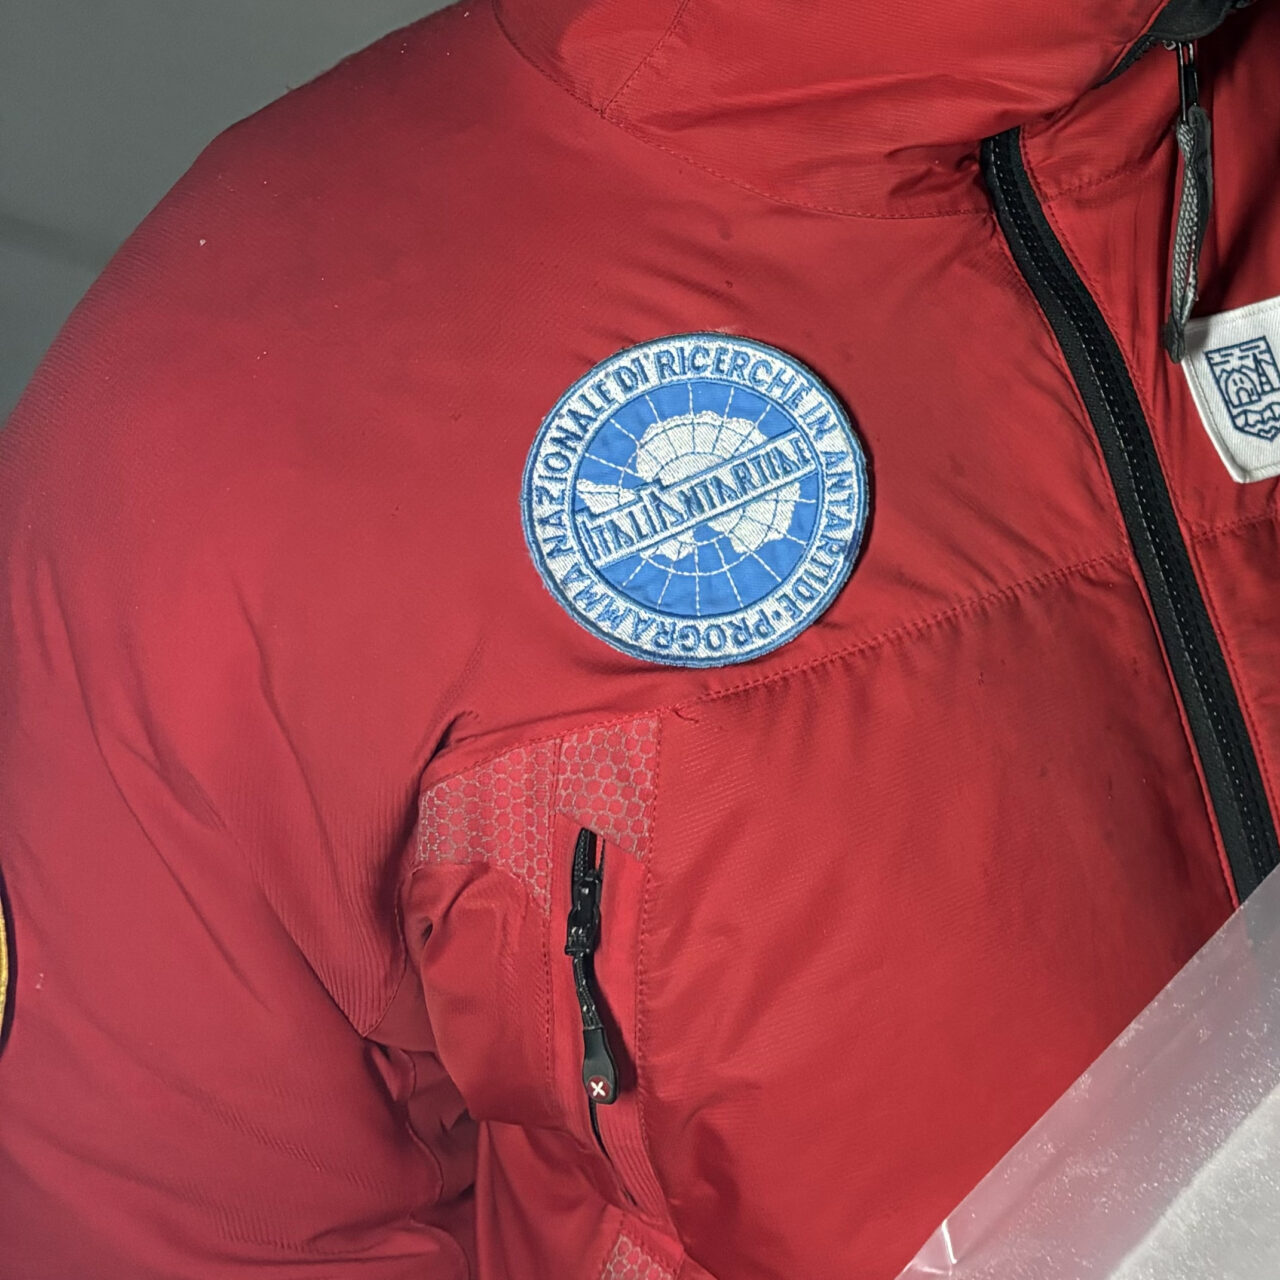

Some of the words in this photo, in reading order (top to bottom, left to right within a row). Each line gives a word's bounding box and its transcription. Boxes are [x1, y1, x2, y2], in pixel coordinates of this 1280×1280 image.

[610, 359, 649, 394] DI
[653, 345, 812, 409] RICERCHE
[802, 398, 839, 441] IN
[532, 379, 622, 558] NAZIONALE
[774, 448, 855, 620] ANTARTIDE
[562, 563, 777, 656] PROGRAMMA
